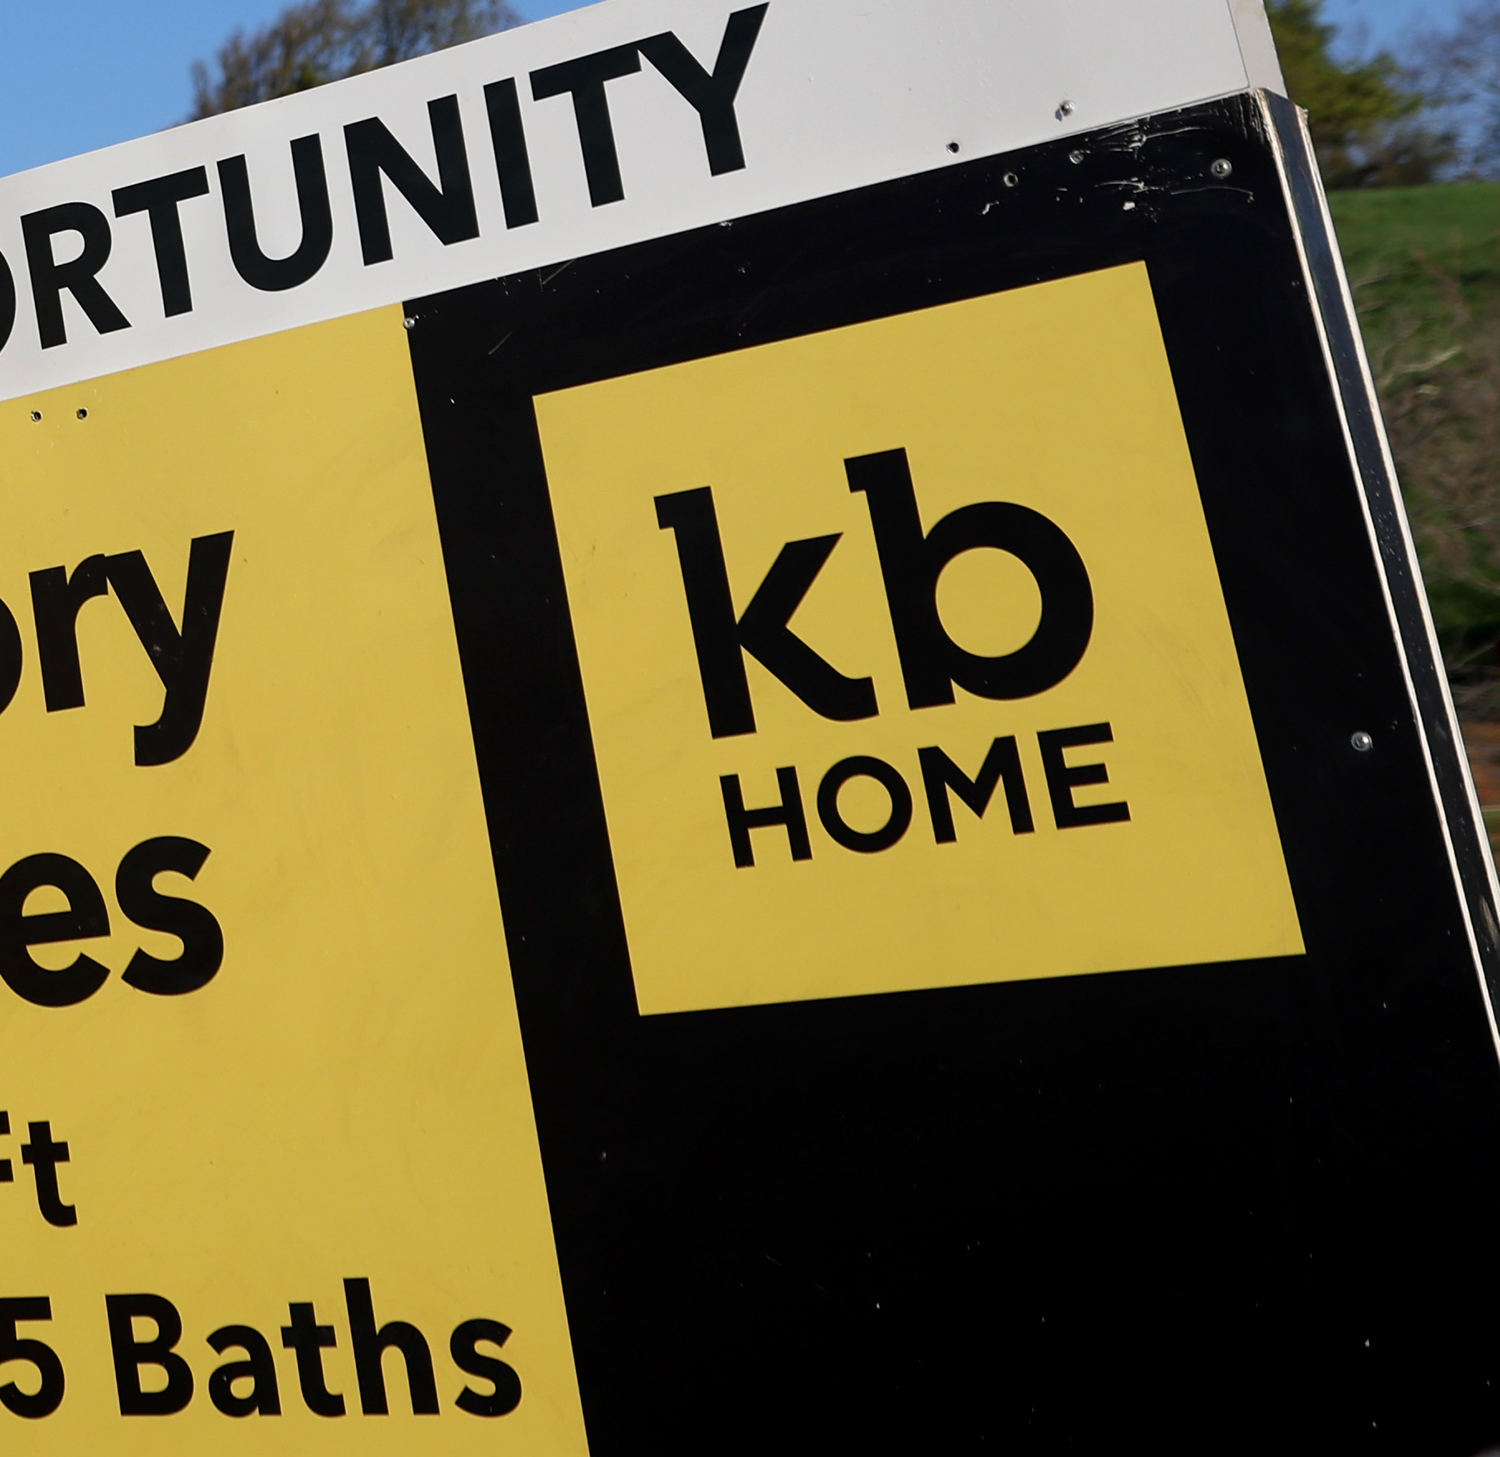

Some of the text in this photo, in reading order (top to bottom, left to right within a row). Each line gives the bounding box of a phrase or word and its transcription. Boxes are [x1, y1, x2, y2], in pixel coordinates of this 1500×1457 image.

[654, 447, 1094, 740] kb
[719, 721, 1131, 869] HOME
[105, 1277, 523, 1418] Baths
